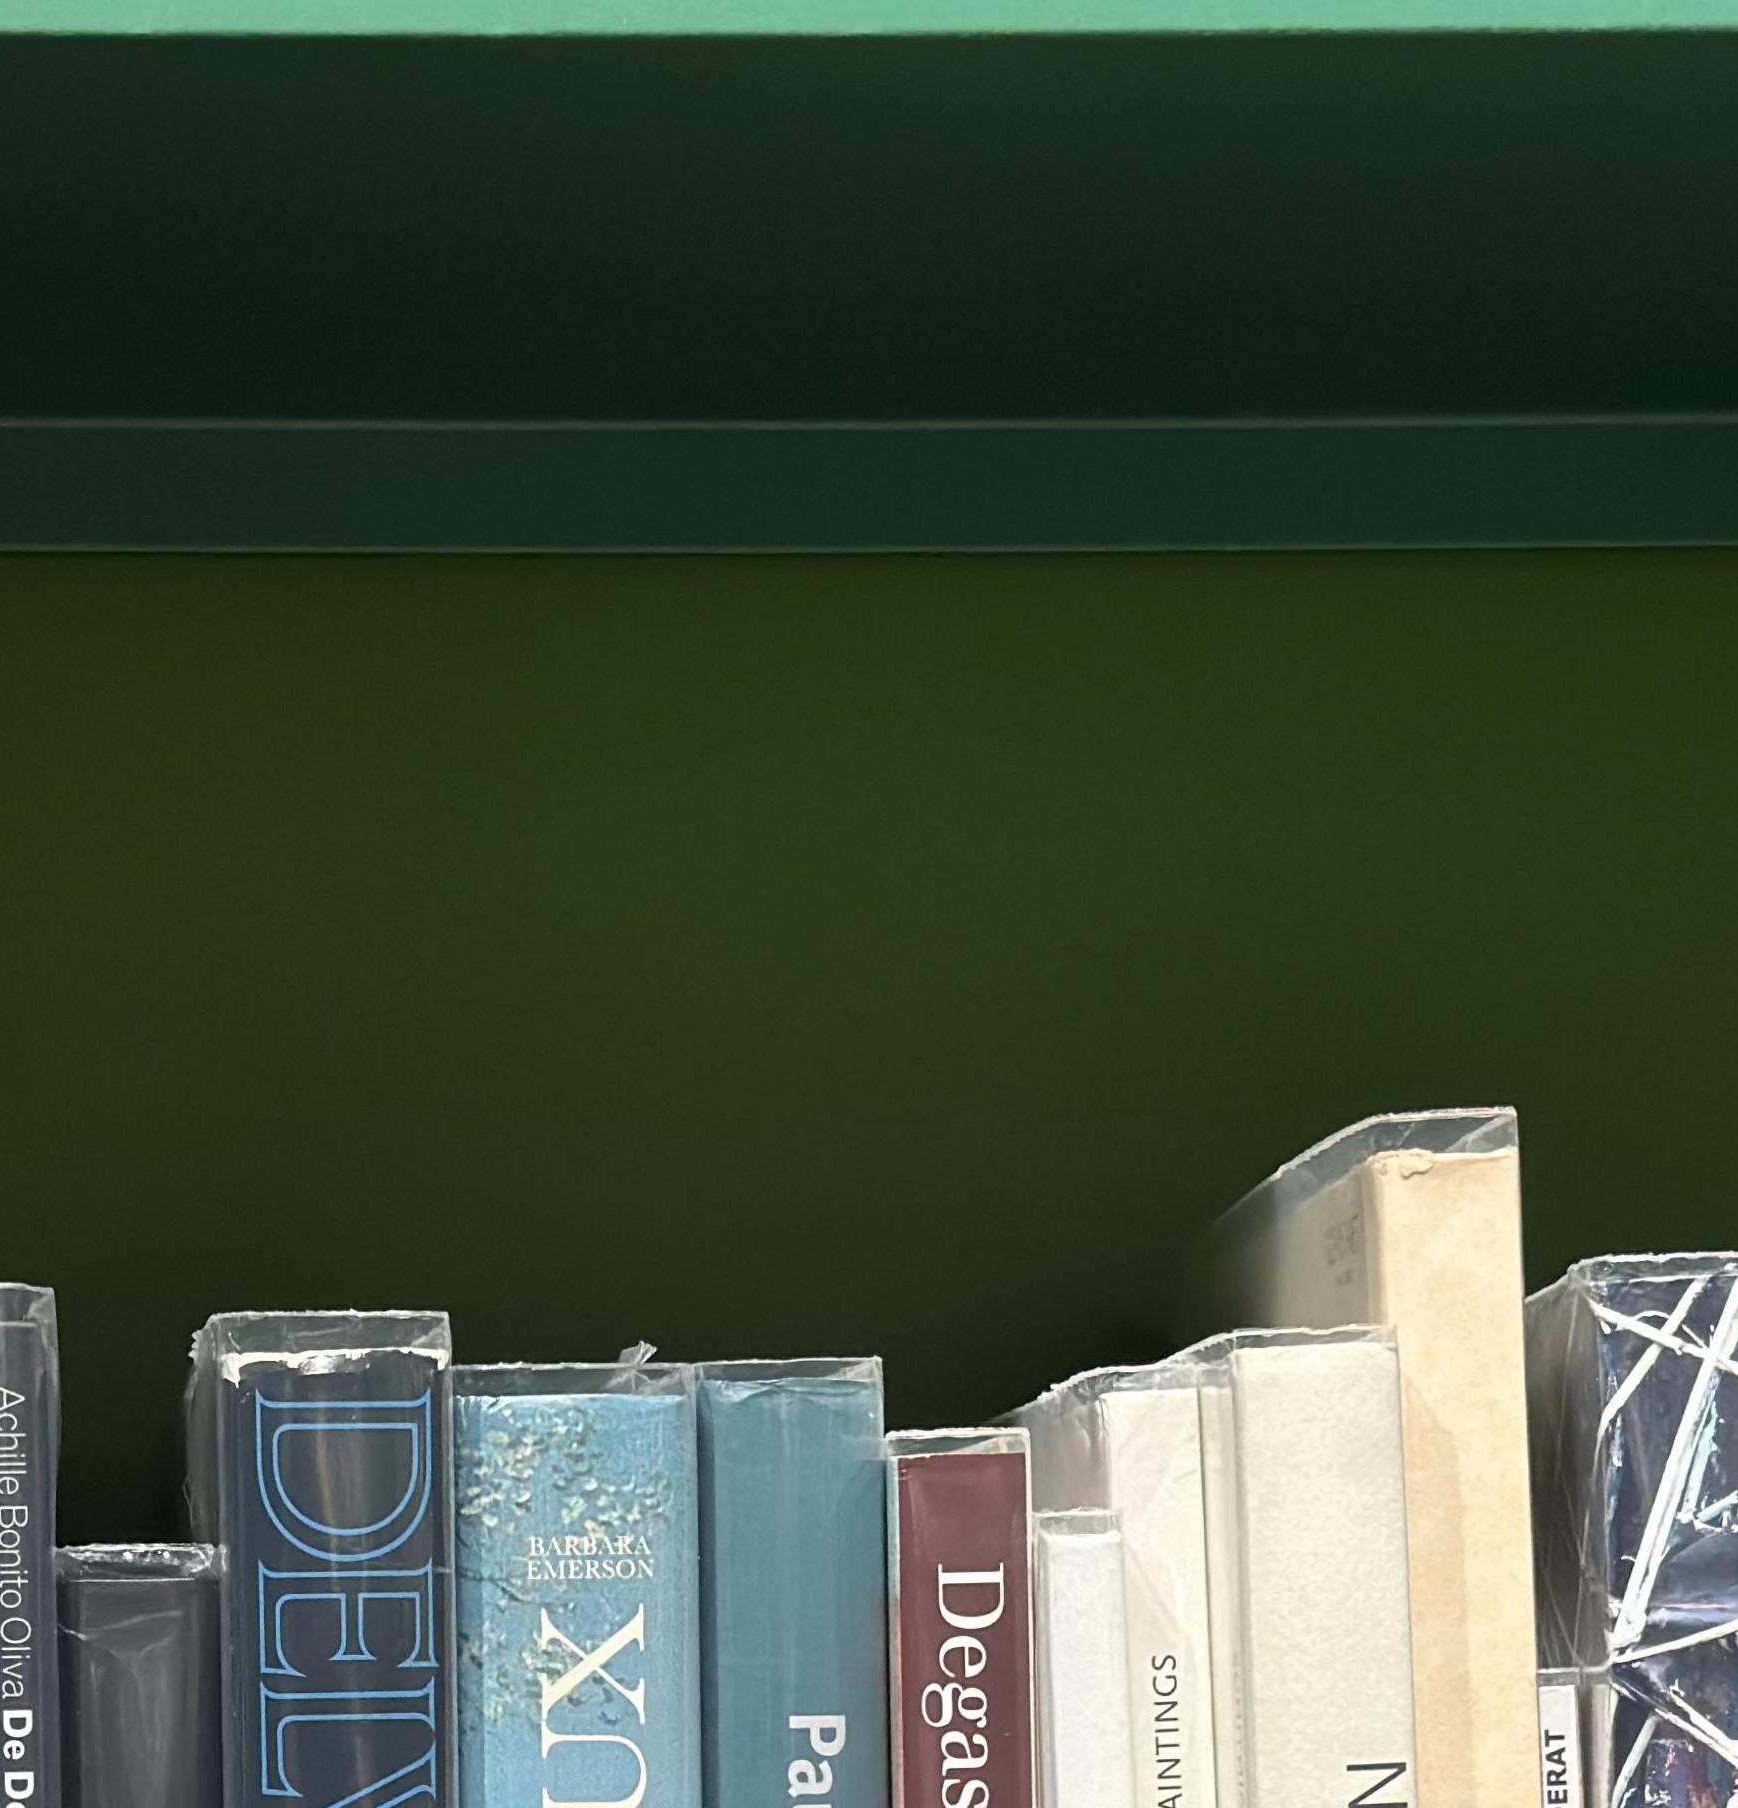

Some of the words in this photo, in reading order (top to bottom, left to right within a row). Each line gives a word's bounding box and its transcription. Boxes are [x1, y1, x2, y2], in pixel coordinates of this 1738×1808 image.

[527, 1535, 652, 1556] BARBARA
[526, 1558, 655, 1580] EMERSON
[0, 1613, 32, 1697] Oliva
[1, 1705, 33, 1757] De
